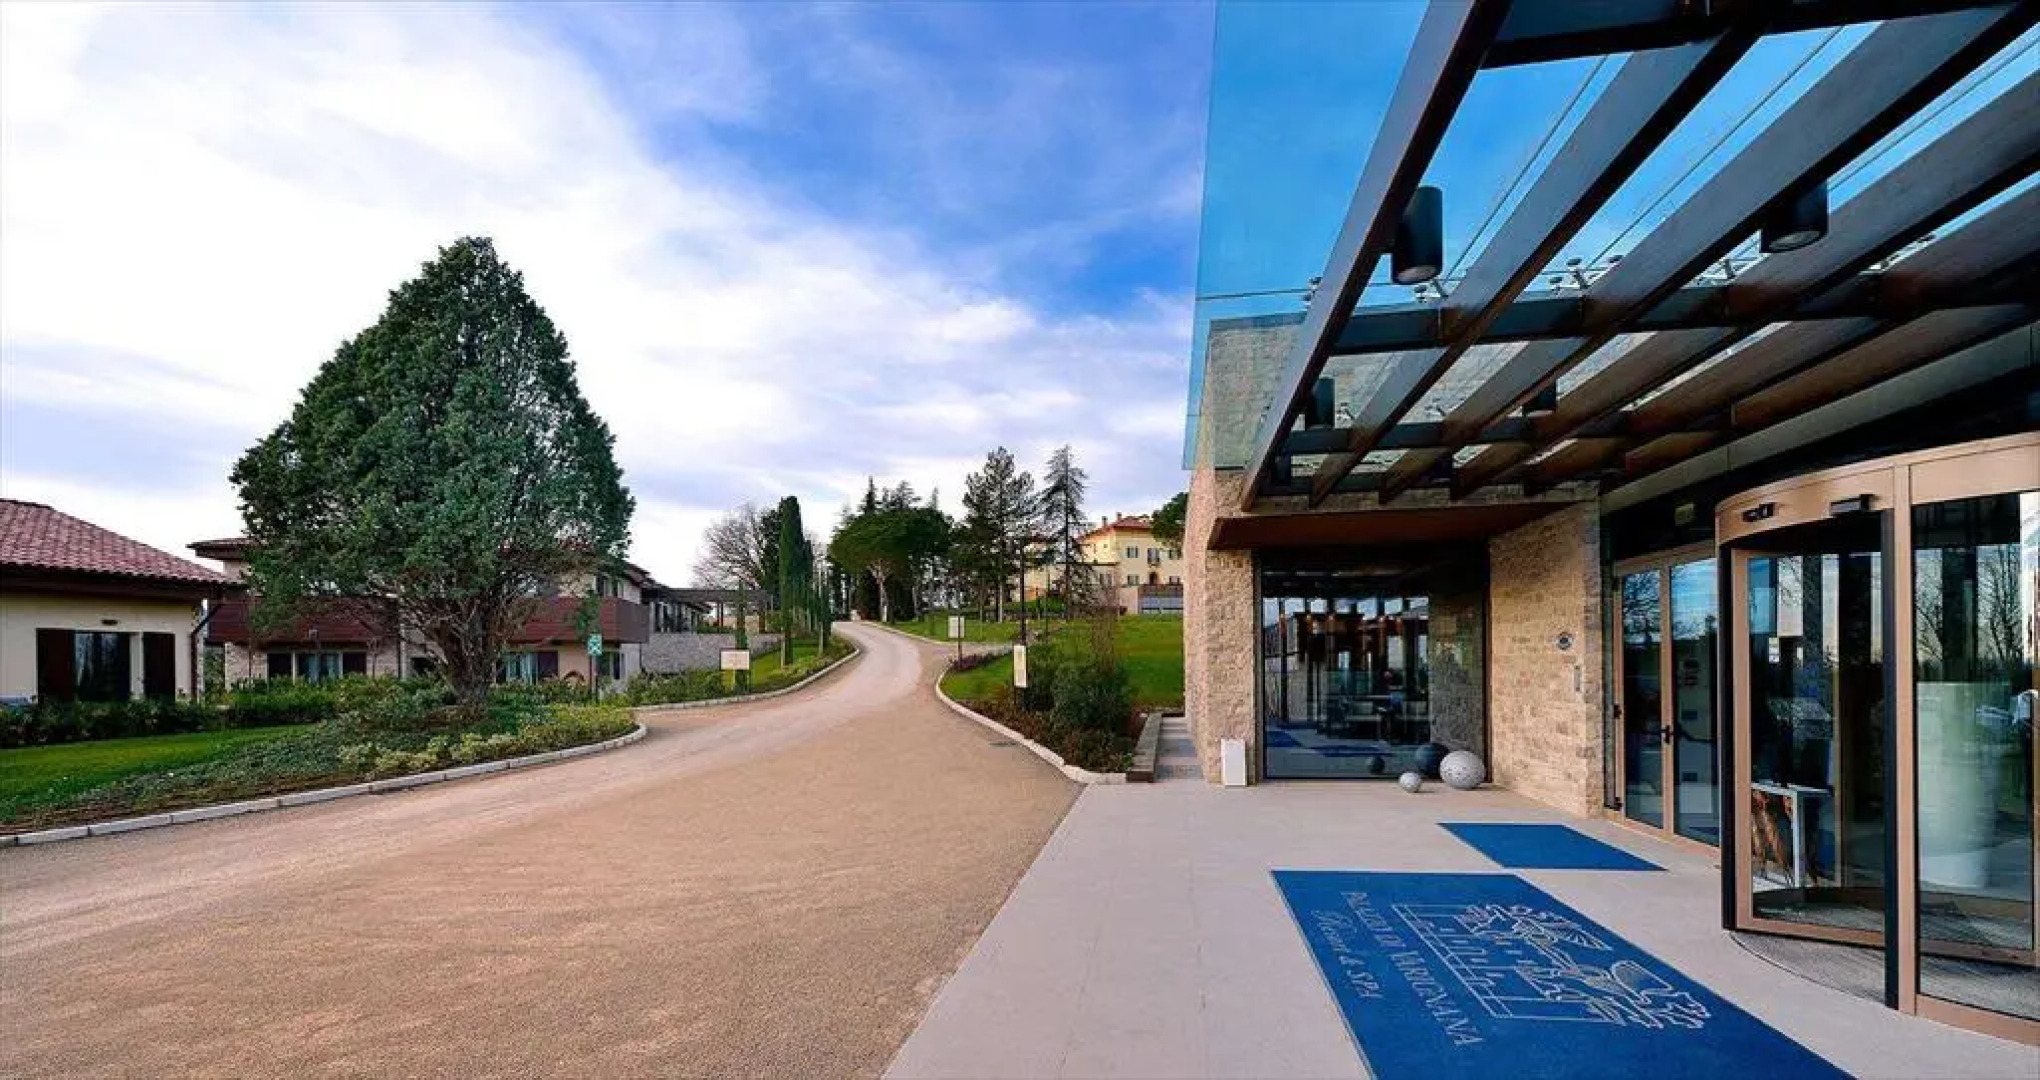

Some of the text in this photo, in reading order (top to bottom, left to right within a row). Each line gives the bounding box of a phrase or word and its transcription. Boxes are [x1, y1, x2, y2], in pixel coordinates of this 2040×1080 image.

[1339, 955, 1365, 966] &
[1347, 970, 1384, 998] SPA
[1390, 951, 1484, 1046] VARIGNANA
